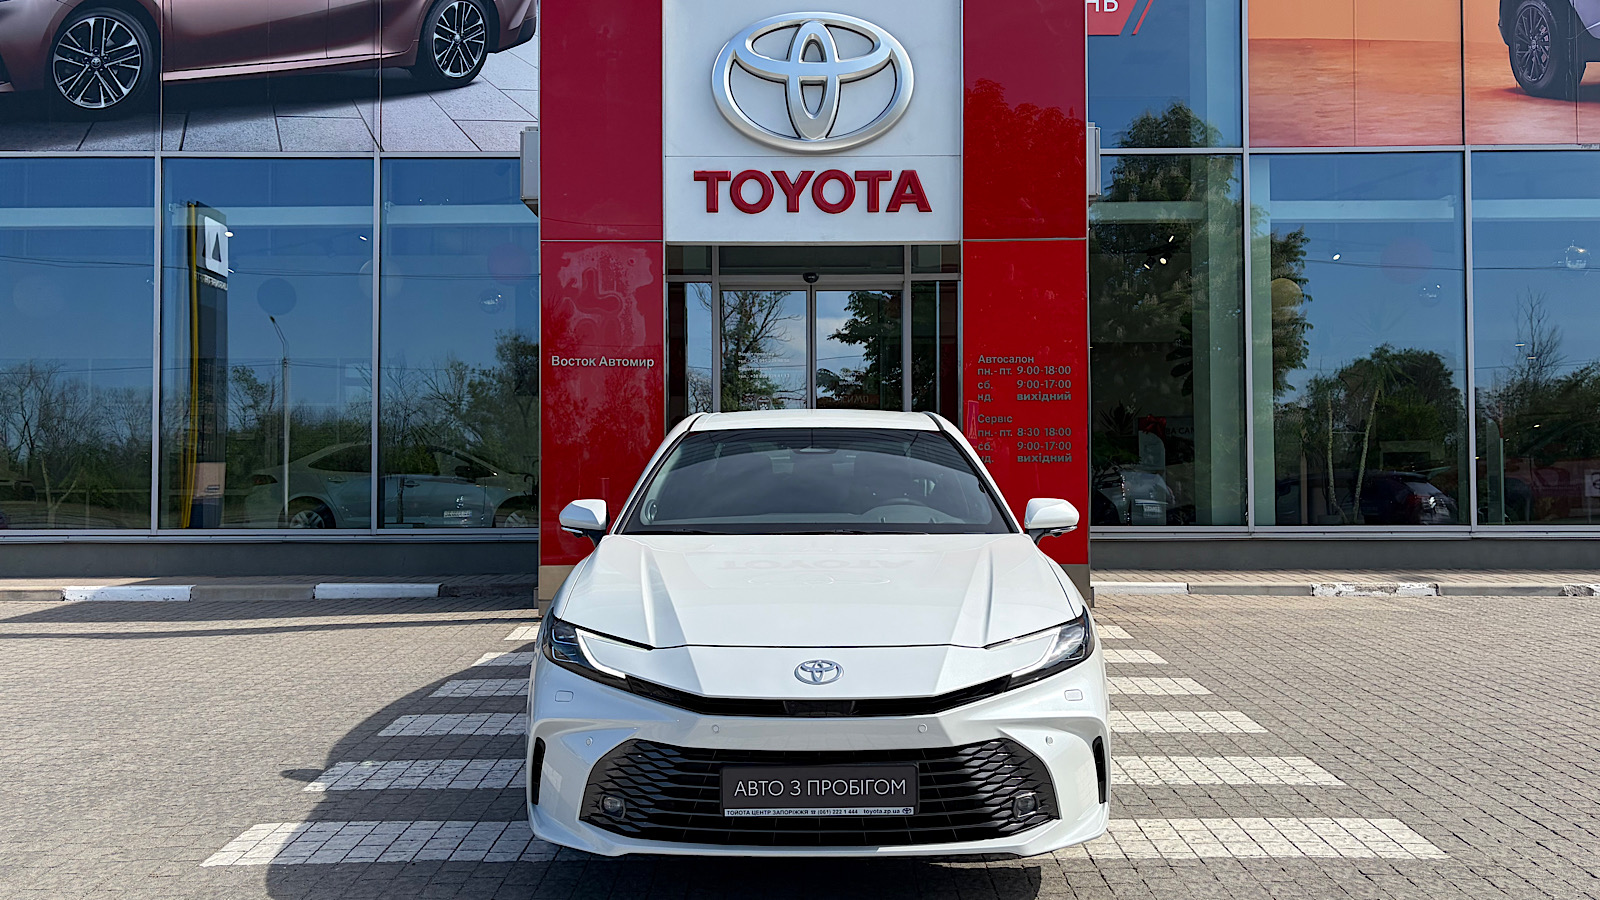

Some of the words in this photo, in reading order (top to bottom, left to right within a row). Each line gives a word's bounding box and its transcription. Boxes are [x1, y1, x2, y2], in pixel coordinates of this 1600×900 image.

[694, 169, 932, 214] TOYOTA
[551, 355, 597, 367] Восток
[599, 355, 655, 369] Автомир
[977, 354, 1035, 364] Автосалон
[977, 380, 994, 390] сб.
[1016, 379, 1072, 389] 9:00-17:00
[977, 393, 994, 402] нд.
[1016, 391, 1072, 402] вихідний
[977, 441, 994, 451] сб.
[1016, 441, 1072, 451] 9:00-17:00
[1017, 452, 1073, 464] вихідний
[733, 780, 784, 797] АВТО
[807, 778, 907, 796] ПРОБІГОМ
